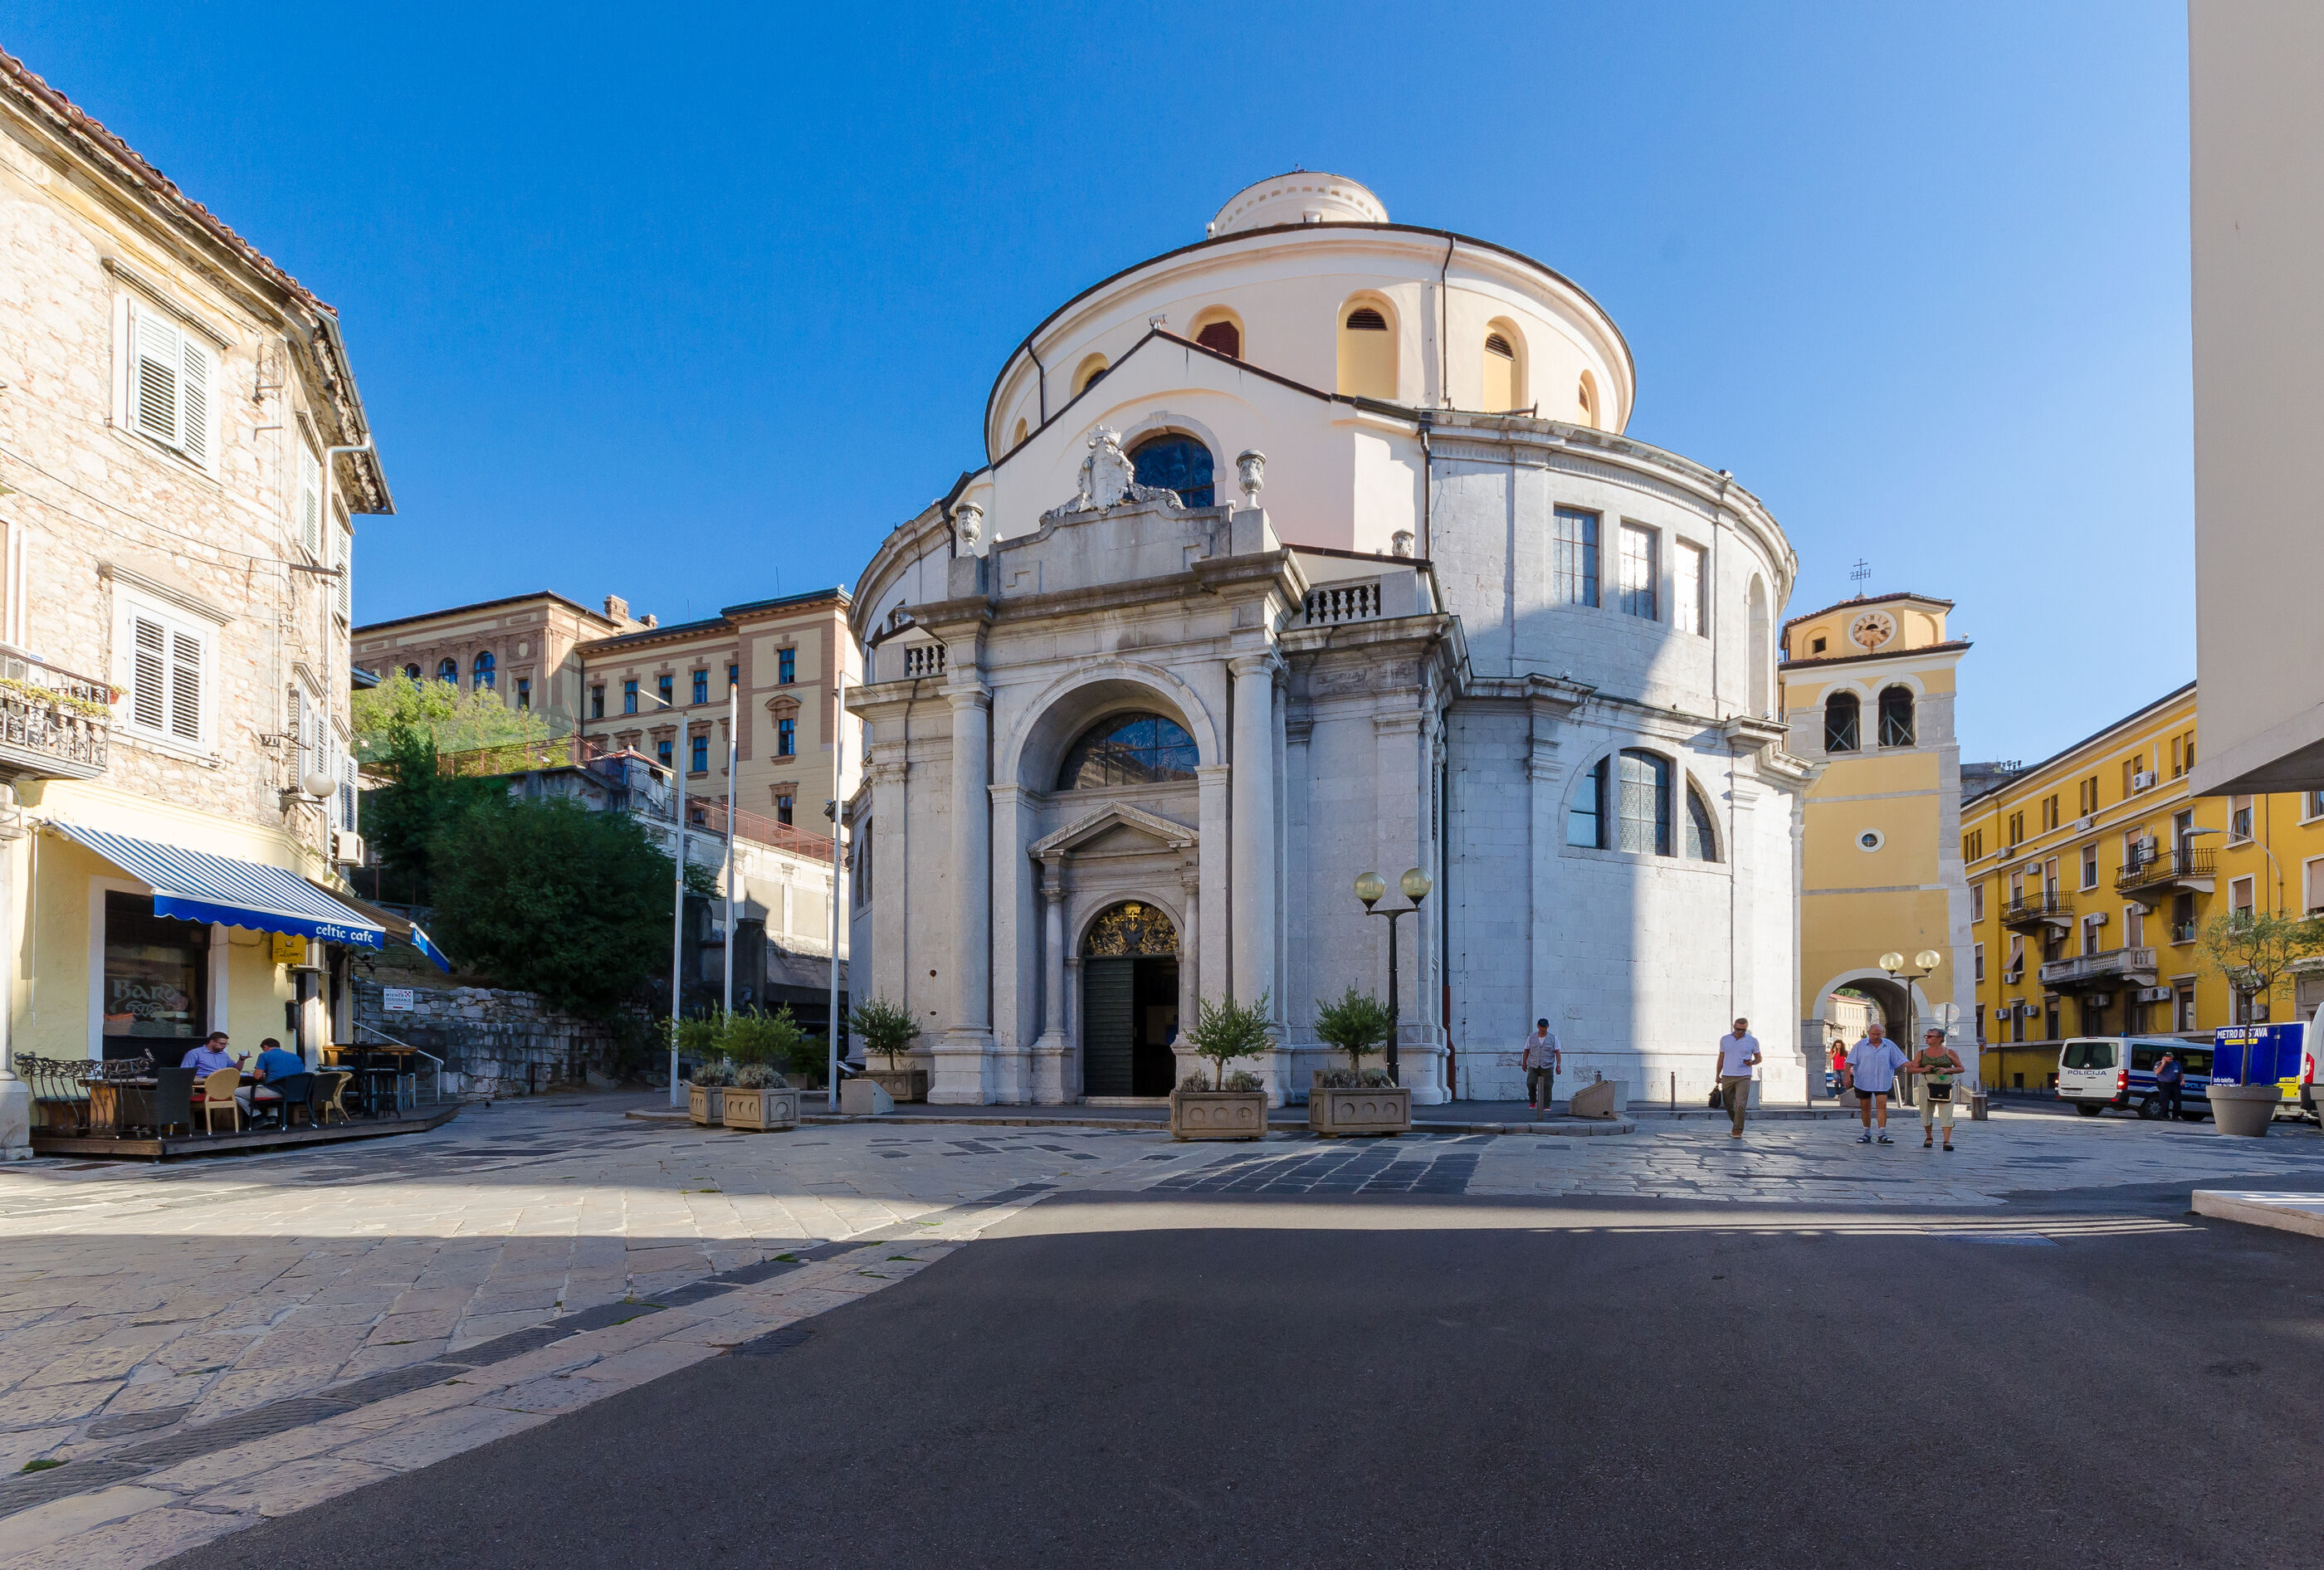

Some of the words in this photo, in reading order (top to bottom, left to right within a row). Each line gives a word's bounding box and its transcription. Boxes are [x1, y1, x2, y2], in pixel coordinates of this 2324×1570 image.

[316, 924, 346, 939] celtic
[350, 930, 374, 943] cafe
[2217, 1029, 2238, 1039] METRO
